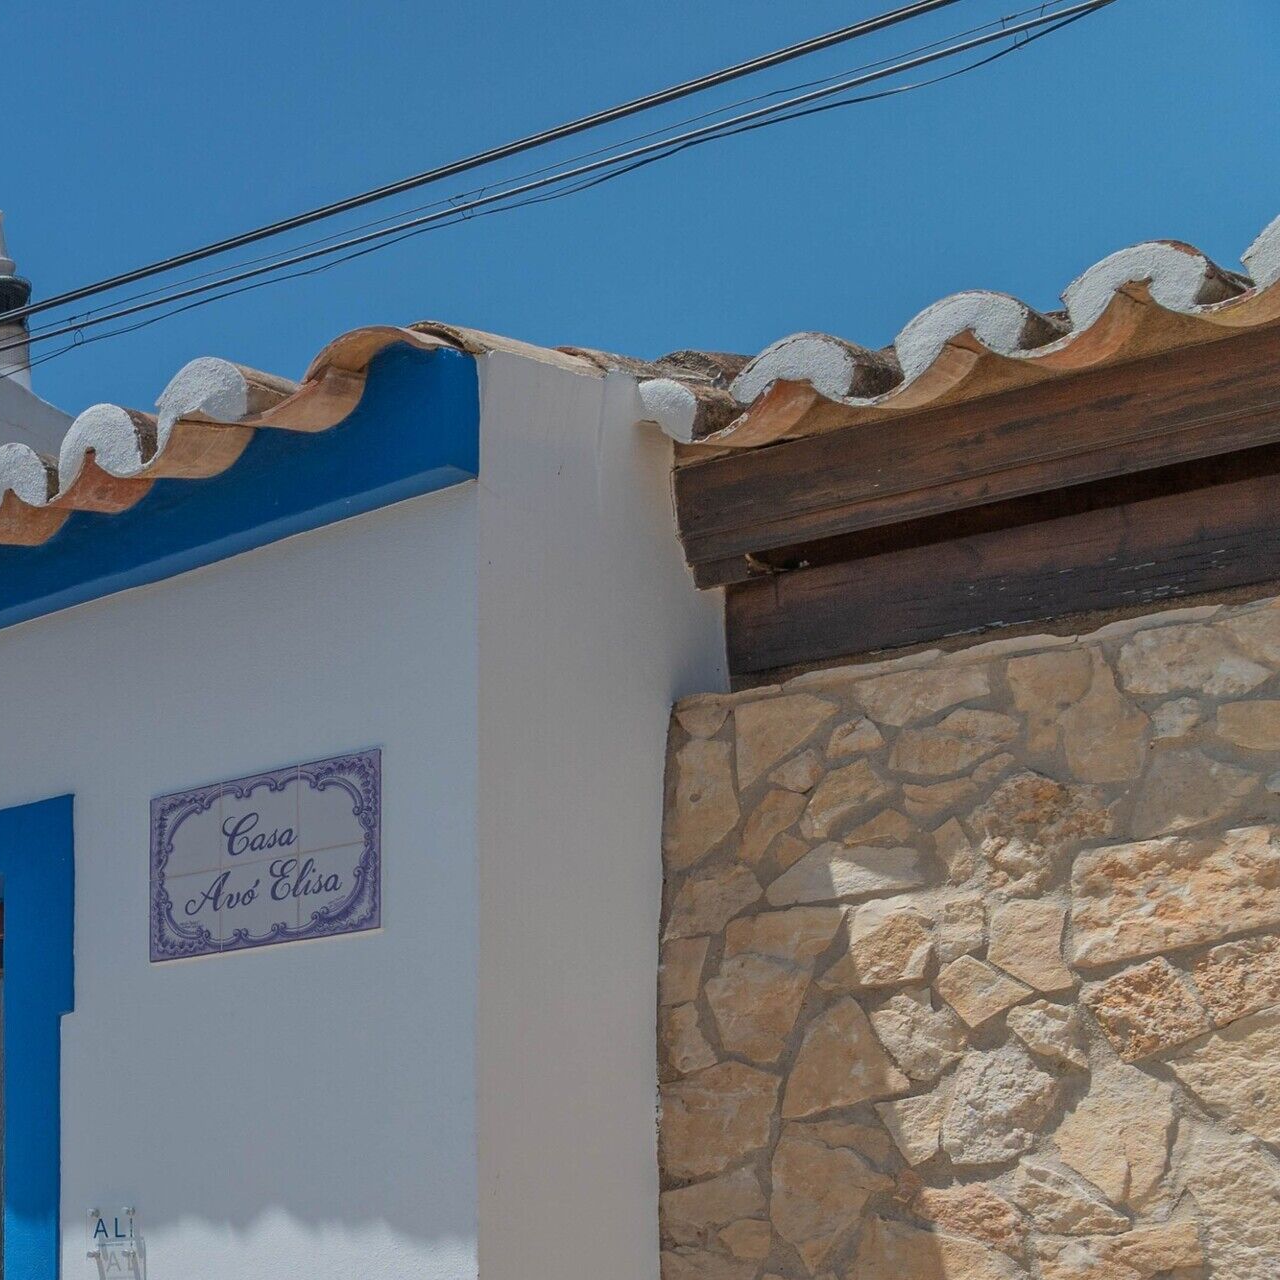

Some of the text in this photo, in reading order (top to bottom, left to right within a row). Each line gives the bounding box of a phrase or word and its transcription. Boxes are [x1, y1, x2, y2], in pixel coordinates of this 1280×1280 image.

[221, 812, 298, 856] Casa
[184, 857, 342, 916] Avó Elisa
[93, 1217, 127, 1239] AL
